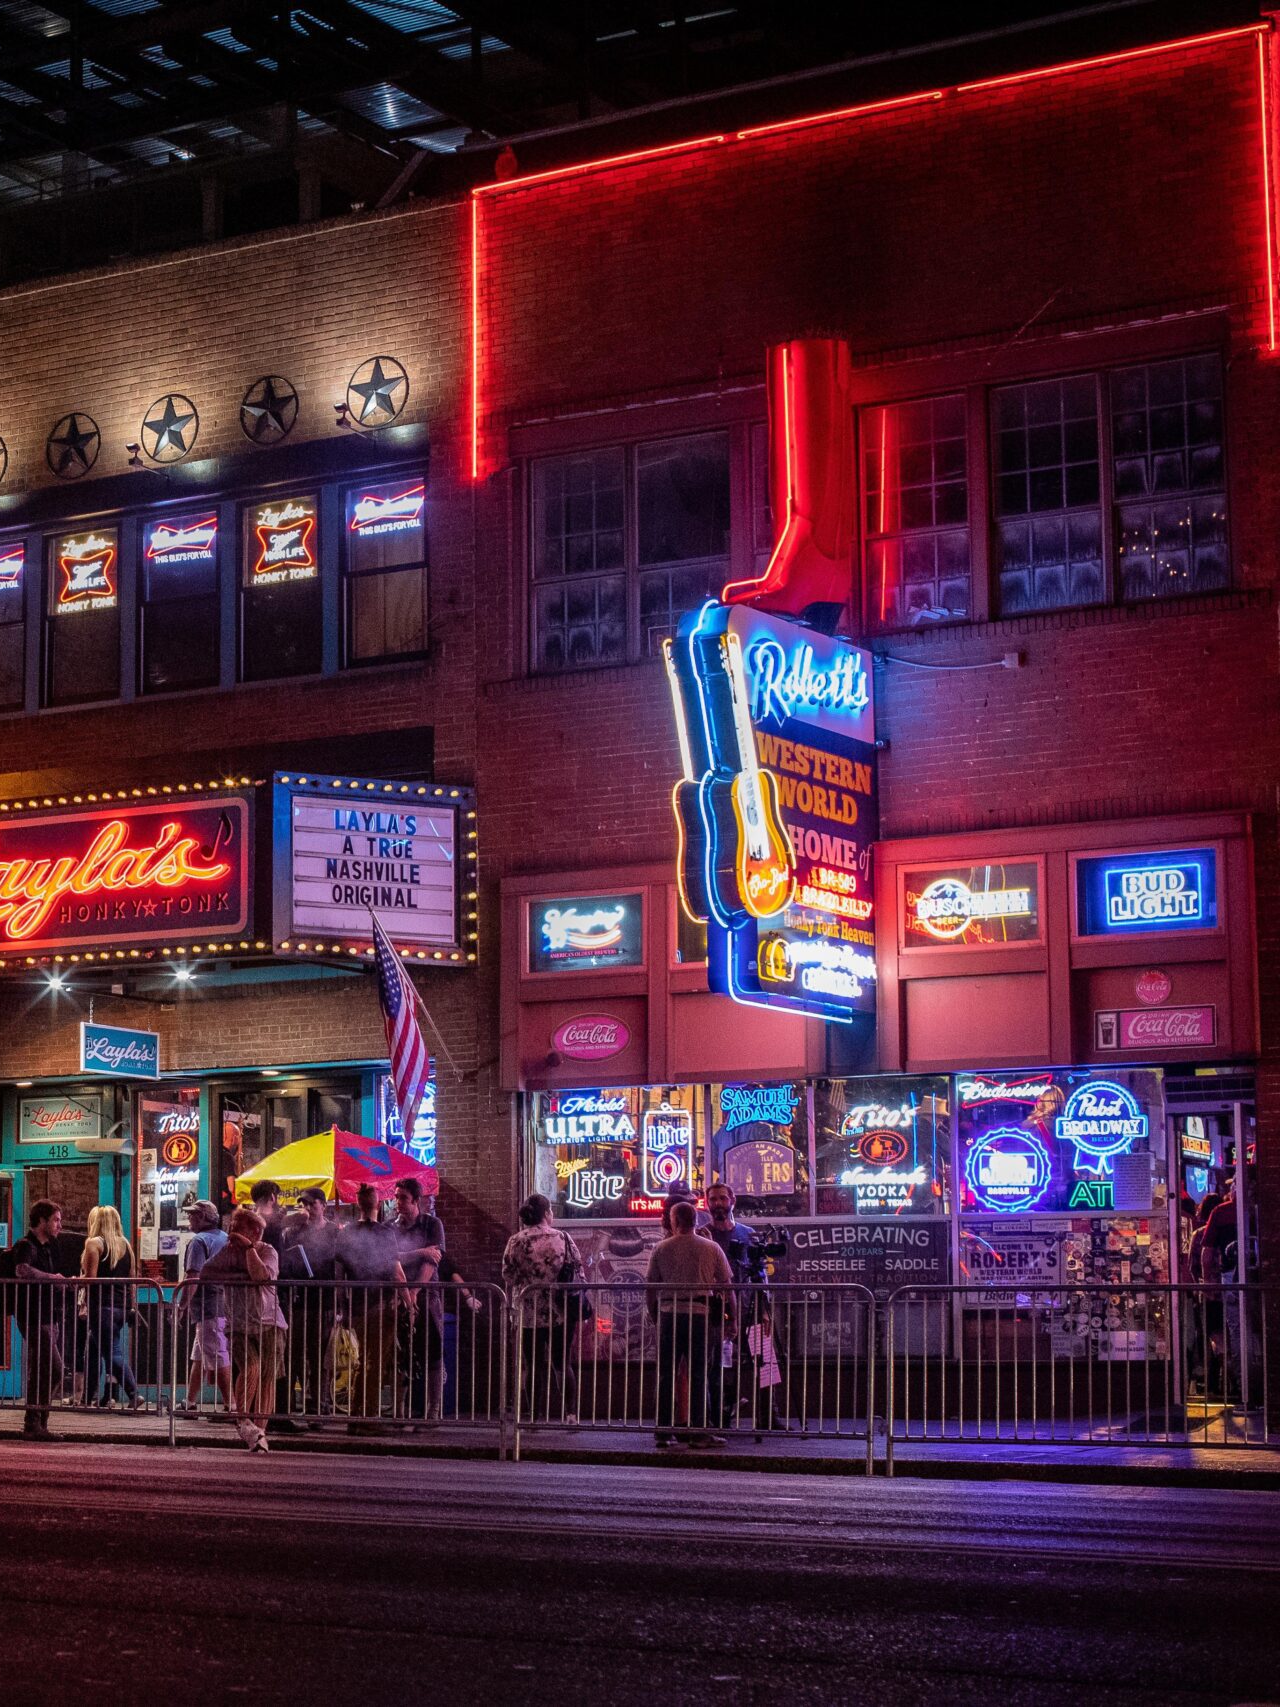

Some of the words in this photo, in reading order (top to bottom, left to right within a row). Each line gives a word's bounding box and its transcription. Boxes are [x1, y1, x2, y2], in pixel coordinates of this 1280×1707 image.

[287, 546, 306, 558] LIFE
[88, 576, 106, 587] LIFE
[747, 638, 869, 723] Robert's
[756, 731, 872, 796] WESTERN
[777, 774, 859, 826] WORLD
[333, 808, 417, 836] LAYLA'S
[342, 835, 354, 855] A
[366, 837, 413, 859] TRUE
[787, 824, 857, 871] HOME
[859, 844, 872, 881] of
[326, 857, 421, 884] NASHVILLE
[1122, 869, 1186, 898] BUD
[59, 900, 143, 926] HONKY
[163, 891, 231, 917] TONK
[332, 884, 418, 909] ORIGINAL
[815, 914, 840, 938] Tonk
[840, 919, 875, 946] Heaven
[86, 1037, 156, 1068] Layla's
[720, 1084, 799, 1111] SAMUEL
[958, 1081, 1051, 1100] Budweiser
[30, 1103, 92, 1132] Layla's
[561, 1096, 627, 1115] Michelob
[725, 1104, 793, 1132] ADAMS
[1077, 1093, 1125, 1118] Pabst
[158, 1111, 200, 1134] Tito's
[545, 1113, 636, 1139] ULTRA
[1061, 1118, 1142, 1137] BROADWAY
[48, 1145, 69, 1158] 418
[588, 1135, 611, 1143] LIGHT
[566, 1170, 625, 1209] Lite
[857, 1185, 909, 1198] VODKA
[1068, 1181, 1115, 1208] AT
[631, 1199, 647, 1211] IT'S
[793, 1226, 930, 1249] CELEBRATING
[840, 1247, 855, 1257] 20
[856, 1247, 884, 1256] YEARS
[970, 1250, 1058, 1269] ROBERT'S
[796, 1259, 867, 1272] JESSEELEE
[884, 1258, 940, 1271] SADDLE
[831, 1275, 862, 1284] WITH
